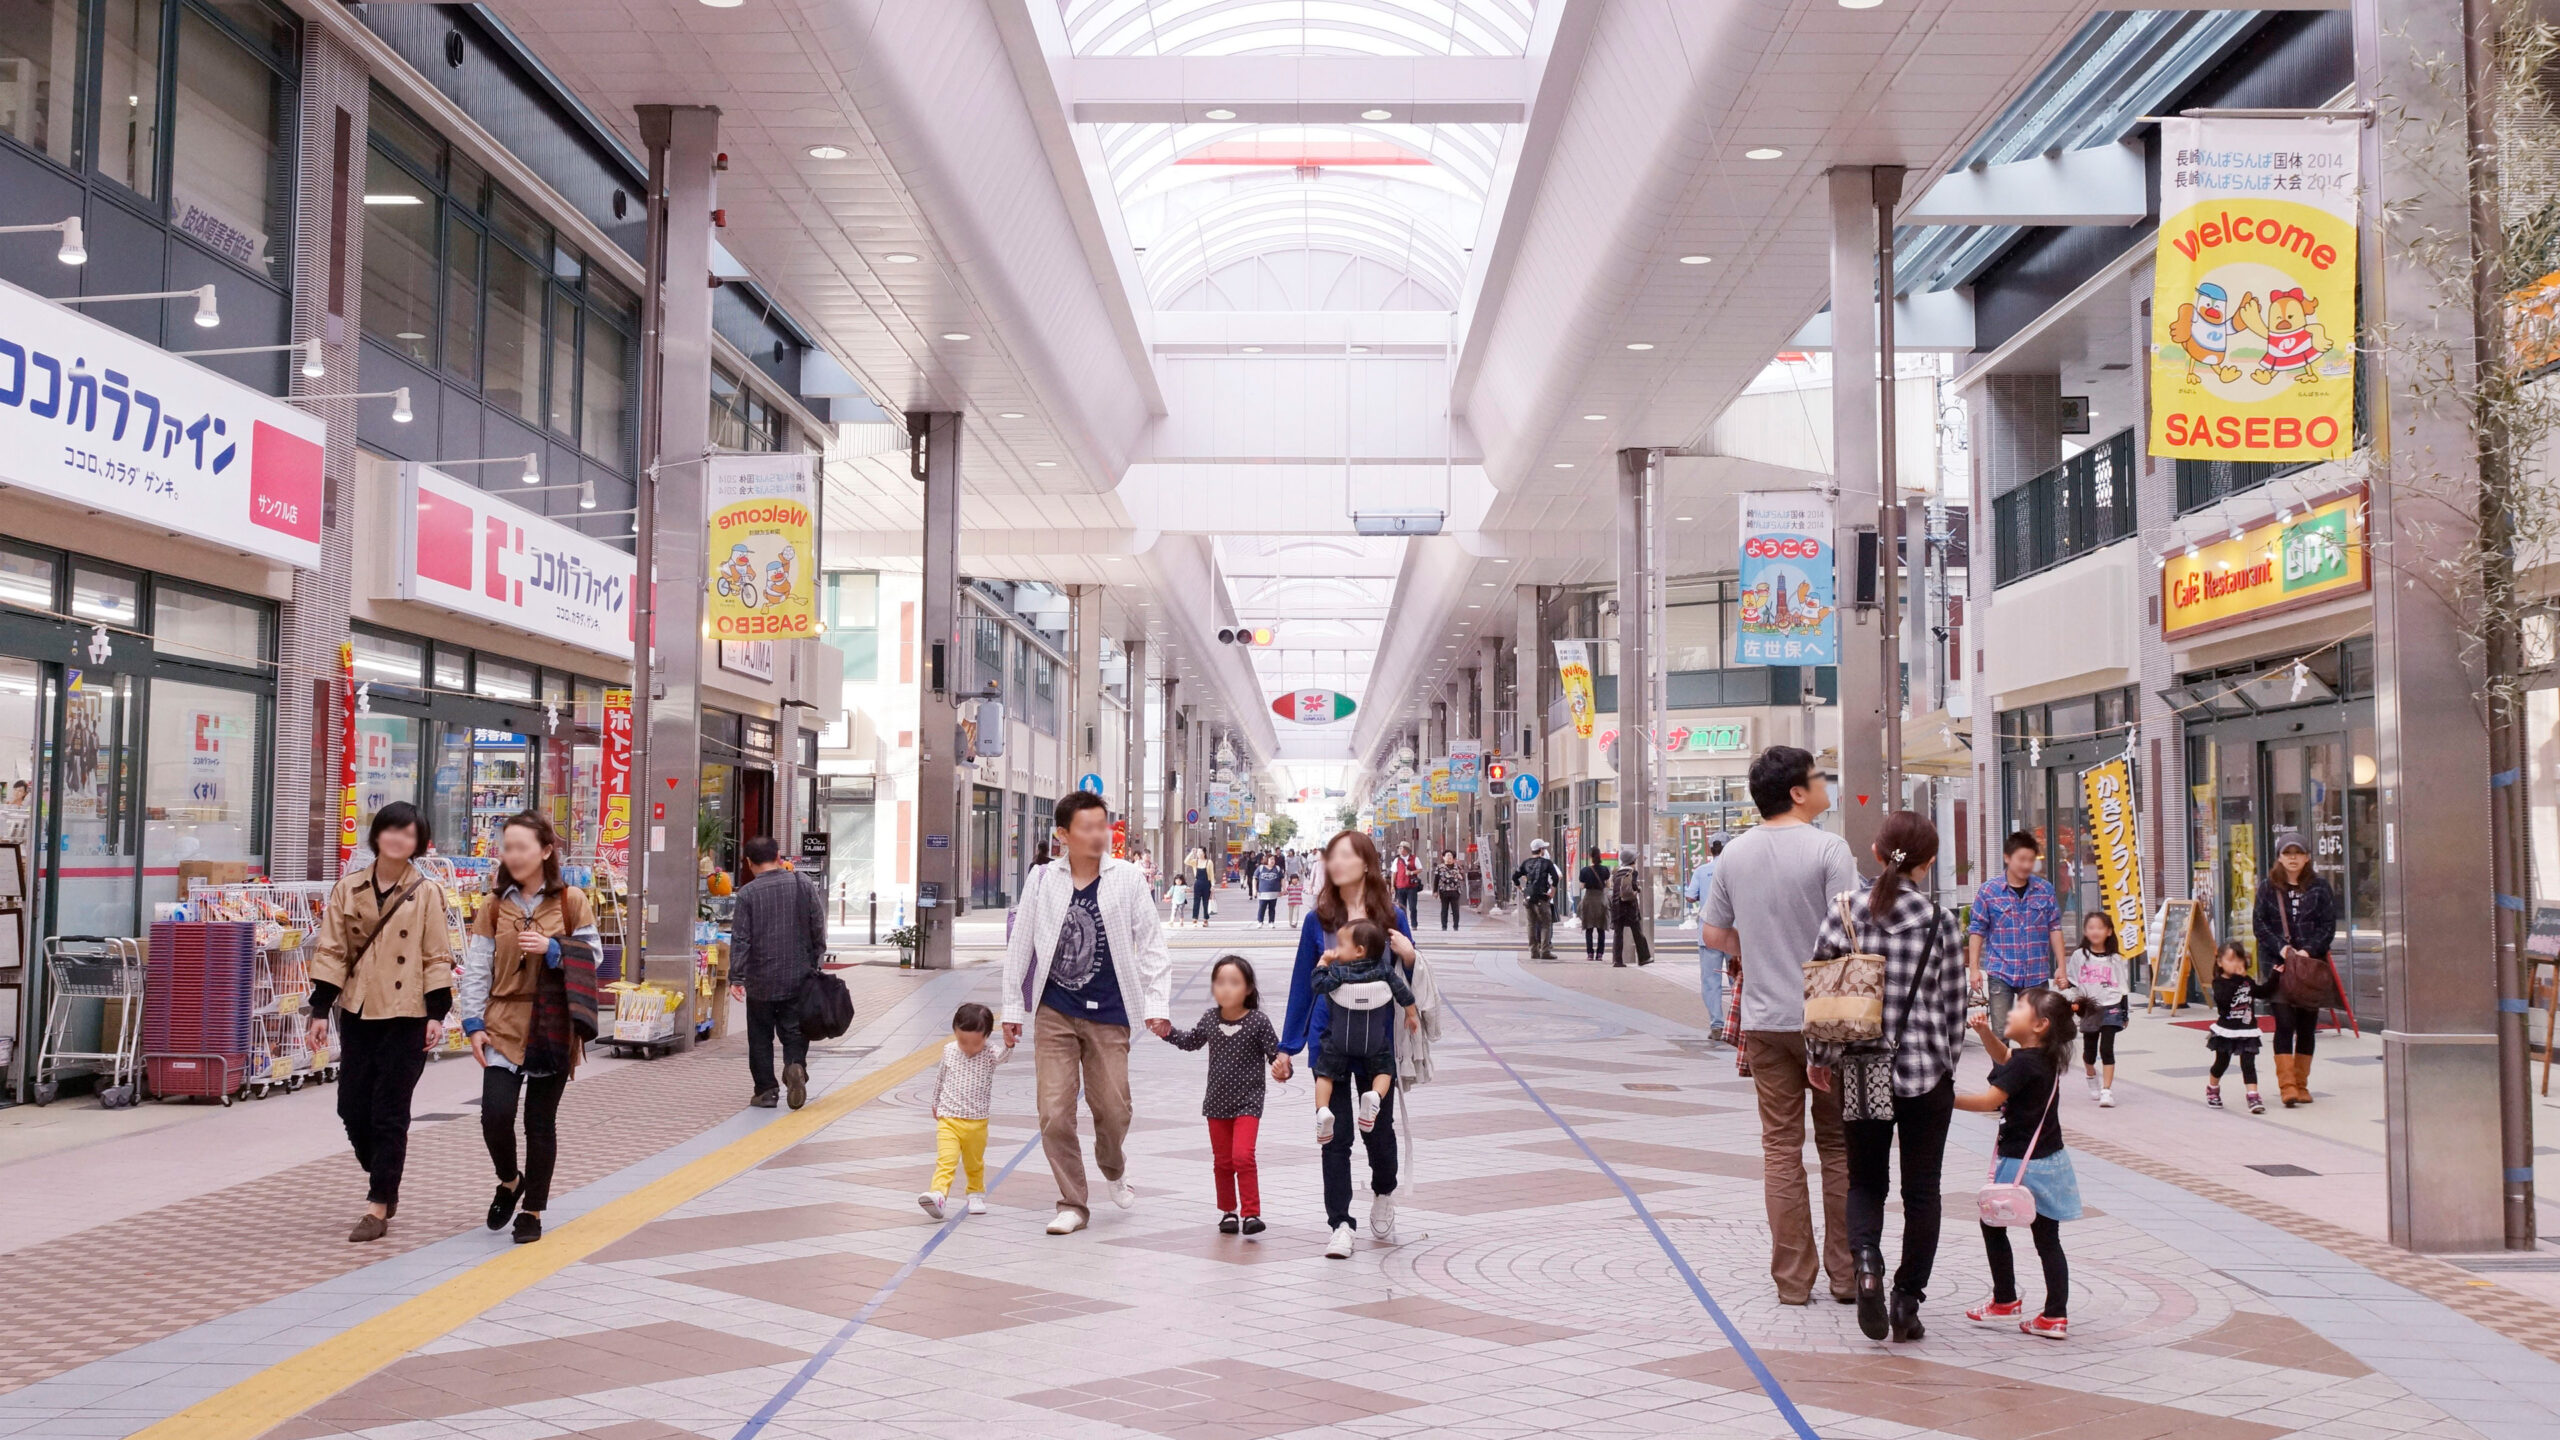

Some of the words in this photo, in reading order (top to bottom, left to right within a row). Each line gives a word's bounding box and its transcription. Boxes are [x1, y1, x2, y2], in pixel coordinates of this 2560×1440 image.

[2307, 153, 2343, 168] 2014
[2307, 175, 2342, 190] 2014
[181, 205, 254, 263] 肢体障害者協会
[2173, 211, 2336, 270] Welcome
[0, 337, 237, 475] ココカラファイン
[2165, 413, 2338, 448] SASEBO
[257, 494, 298, 525] サンクル店
[1807, 510, 1825, 519] 2014
[1807, 520, 1825, 529] 2014
[1748, 539, 1817, 556] ようこそ
[530, 547, 623, 613] ココカラファイン
[2173, 573, 2200, 609] Café
[2203, 558, 2273, 600] Restaurant
[1744, 639, 1825, 658] 佐世保へ
[474, 729, 512, 742] 芳香剤
[1690, 726, 1742, 750] mini
[193, 783, 217, 801] くすり
[367, 793, 385, 809] くすり
[2319, 835, 2343, 855] 白ばら
[2096, 774, 2142, 951] かきフライ定食
